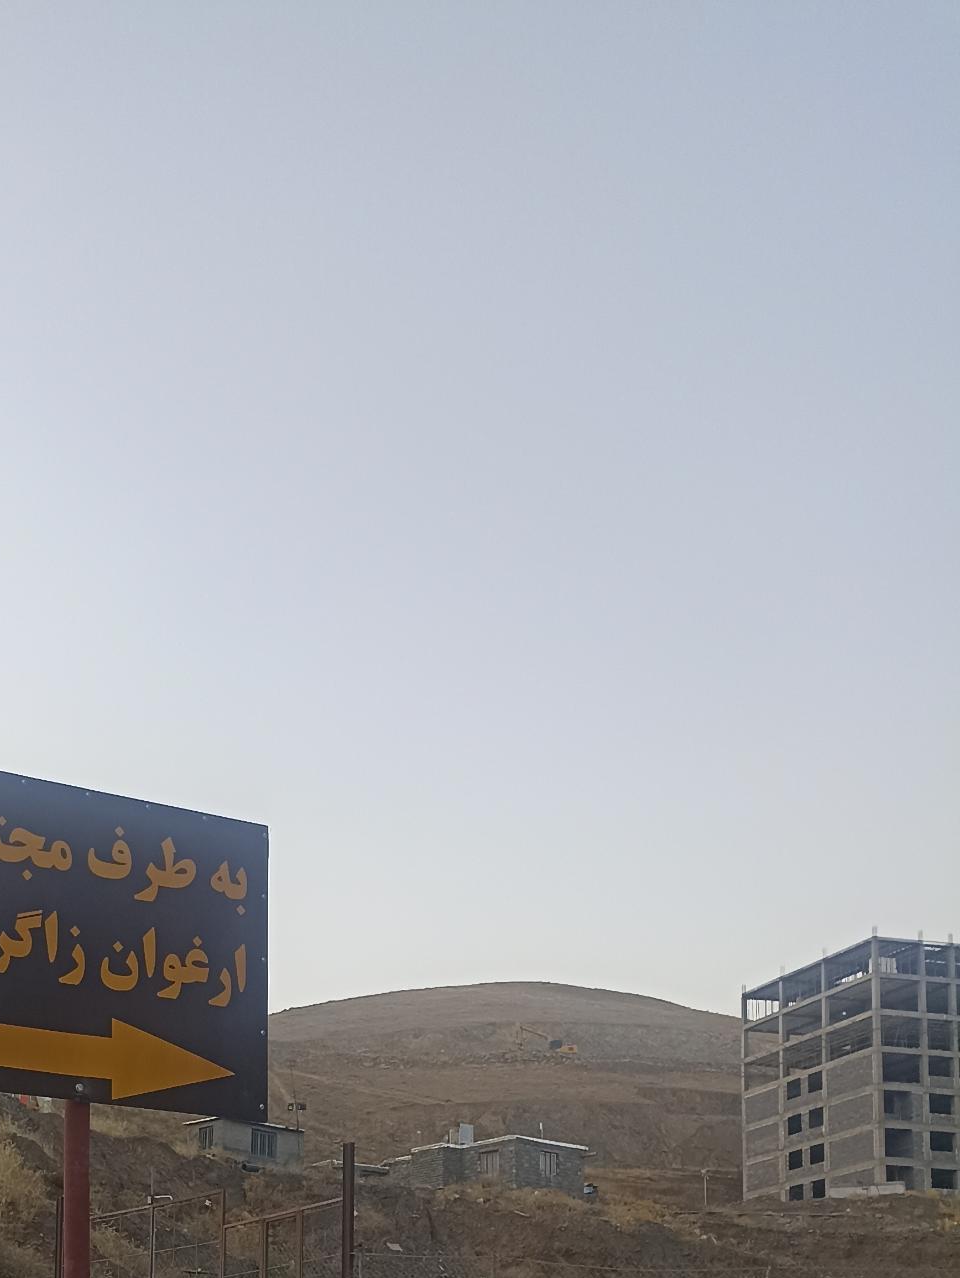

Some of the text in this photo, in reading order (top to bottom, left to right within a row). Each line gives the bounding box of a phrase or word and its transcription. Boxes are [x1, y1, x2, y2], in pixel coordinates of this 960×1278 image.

[87, 826, 197, 902] طرف
[210, 861, 248, 916] به
[100, 927, 247, 1007] ارغوان
